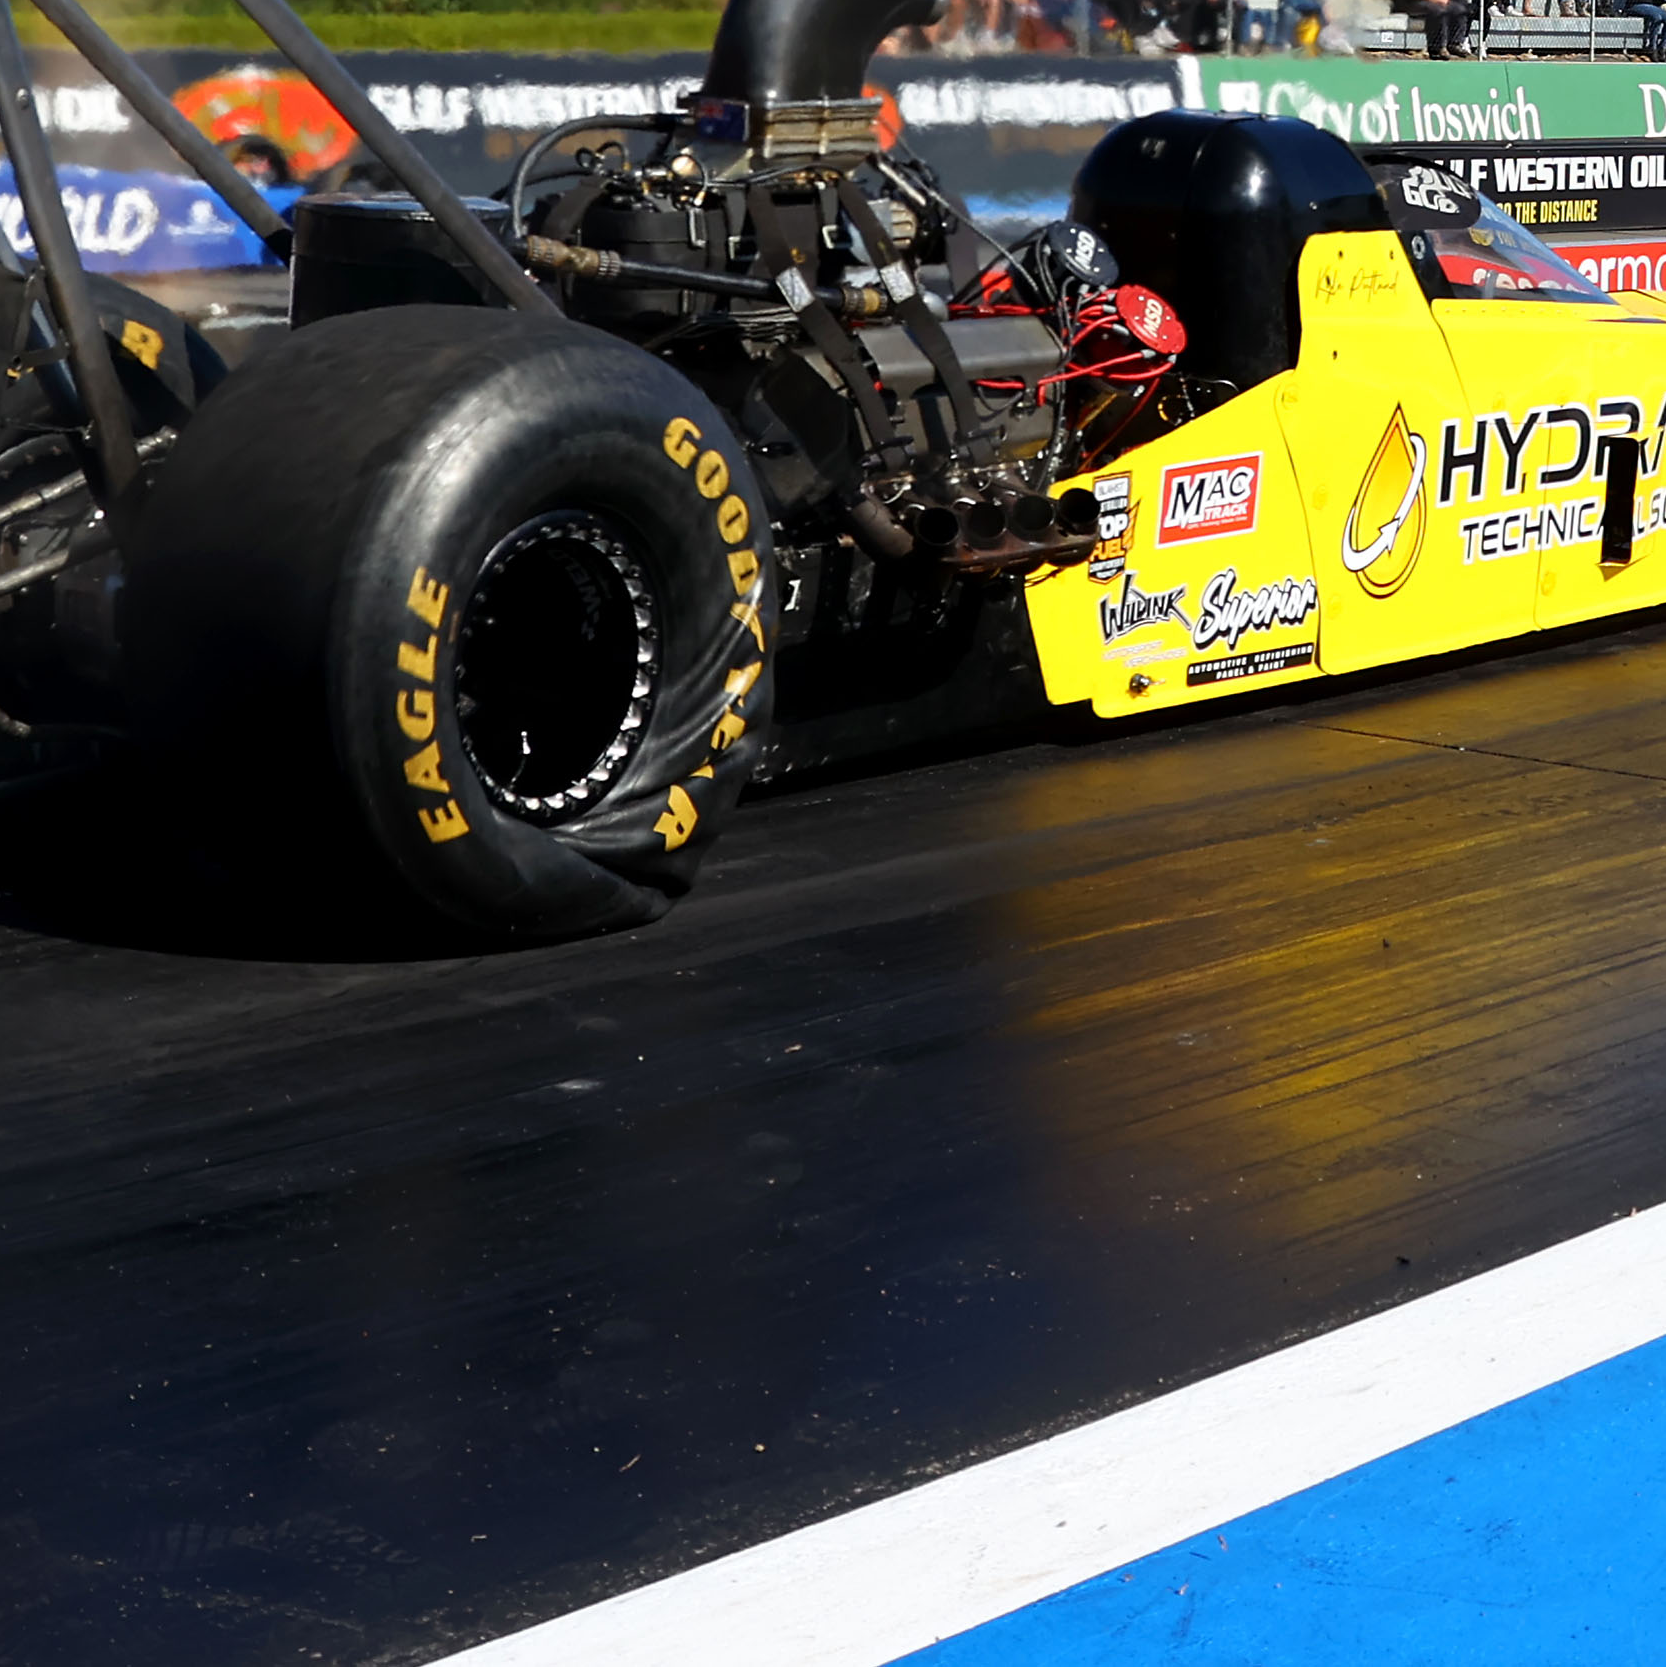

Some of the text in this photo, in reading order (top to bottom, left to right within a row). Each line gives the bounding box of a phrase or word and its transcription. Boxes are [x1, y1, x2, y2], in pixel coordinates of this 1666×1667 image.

[1360, 84, 1400, 142] of
[1411, 86, 1542, 142] Ipswich
[1493, 155, 1624, 193] WESTERN
[1516, 202, 1537, 224] THE
[1540, 199, 1599, 223] DISTANCE
[1074, 230, 1096, 271] MSD
[1143, 298, 1164, 338] MSD
[1167, 468, 1252, 524] MAC
[1204, 502, 1249, 521] TRACK
[1463, 500, 1647, 564] TECHNICL
[1194, 568, 1317, 651] Superior
[1188, 659, 1247, 675] AUTOMOTIVE
[1215, 667, 1245, 680] PANEL
[396, 566, 470, 844] EAGLE
